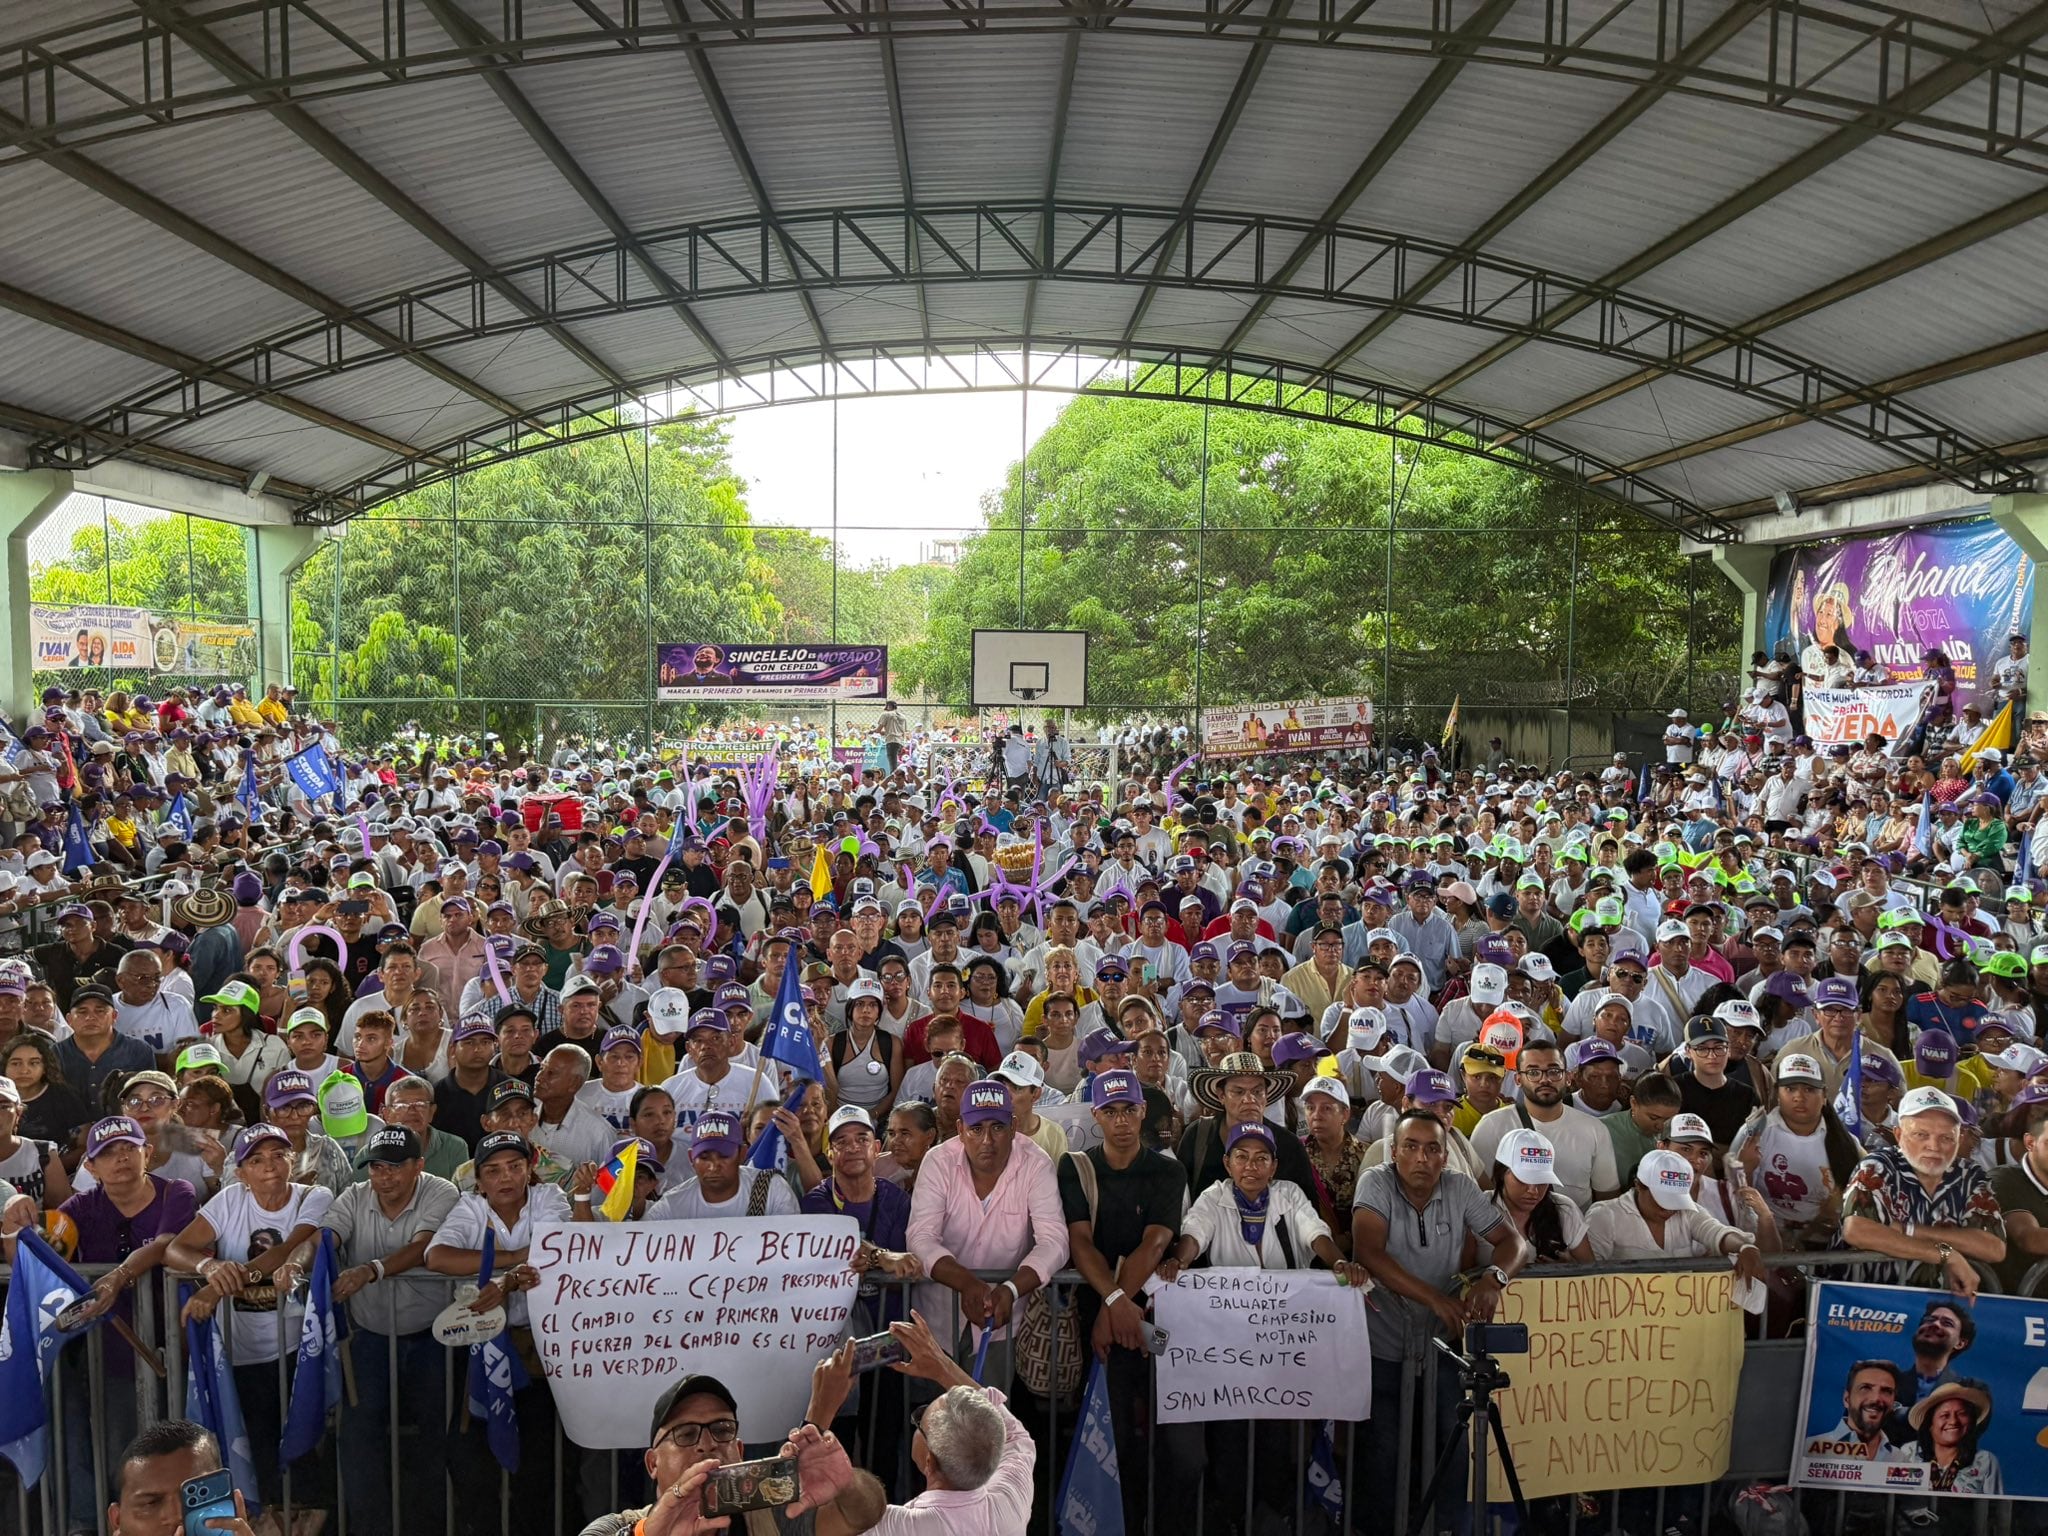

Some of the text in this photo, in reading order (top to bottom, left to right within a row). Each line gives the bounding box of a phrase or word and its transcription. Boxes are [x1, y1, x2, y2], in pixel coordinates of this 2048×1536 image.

[728, 650, 808, 663] SINCELEJO
[816, 650, 874, 662] MORADO
[754, 662, 818, 672] CON CEPEDA
[702, 687, 743, 696] PRIMERO
[794, 687, 828, 695] PRIMERA
[1204, 702, 1280, 715] BIENVENIDO
[1318, 696, 1371, 706] CEPEDA
[1288, 730, 1311, 742] IVÁN
[299, 756, 325, 788] CEPEDA
[540, 1230, 856, 1268] SAN JUAN DE BETULIA
[689, 1274, 768, 1302] CEPEDA
[782, 1272, 856, 1292] PRESIDENTE
[1164, 1274, 1289, 1295] EDERACIÓN
[1210, 1296, 1287, 1310] BALUARTE
[1494, 1282, 1524, 1323] AS
[1540, 1275, 1665, 1323] LLANADAS,
[542, 1306, 848, 1334] EL CAMBIO ES EN PRIMERA VUELTA
[1248, 1310, 1336, 1324] CAMPESINO
[1828, 1304, 1908, 1324] EL PODER
[1828, 1318, 1839, 1326] de
[1848, 1320, 1903, 1334] VERDAD
[544, 1331, 842, 1360] LA FUERZA DEL CAMBIO ES EL PODE
[1256, 1330, 1318, 1345] MOJANA
[1170, 1347, 1307, 1368] PRESENTE
[1528, 1325, 1680, 1373] PRESENTE
[546, 1360, 564, 1378] DE
[574, 1362, 592, 1378] LA
[1164, 1384, 1313, 1411] SAN MARCOS
[1491, 1376, 1714, 1429] IVAN CEPEDA
[1547, 1426, 1683, 1477] AMAMOS
[1808, 1440, 1868, 1456] APOYA
[1808, 1462, 1839, 1470] AGMETH
[1808, 1468, 1862, 1480] SENADOR
[1886, 1466, 1924, 1478] PACTO
